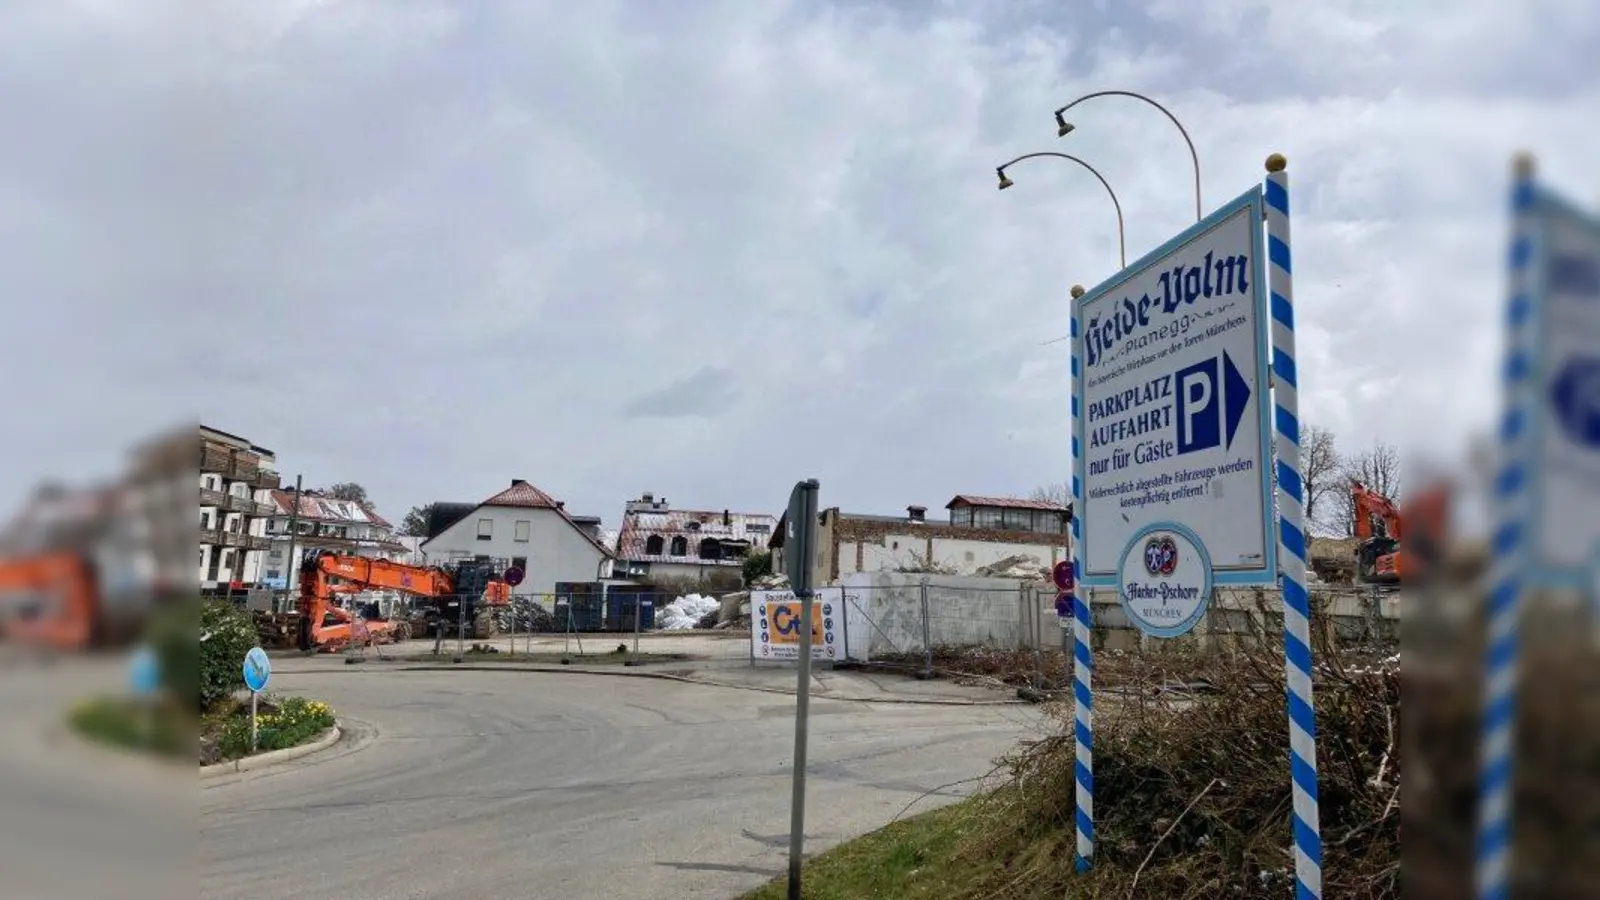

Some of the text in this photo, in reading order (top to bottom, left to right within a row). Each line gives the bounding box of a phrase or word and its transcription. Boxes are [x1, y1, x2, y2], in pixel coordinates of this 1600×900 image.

[1085, 250, 1249, 367] Heide-Volm
[1184, 333, 1204, 349] Toren
[1205, 315, 1247, 340] Münchens
[1089, 375, 1172, 422] PARKPLATZ
[1090, 405, 1172, 449] AUFFAHRT
[1090, 439, 1174, 477] nur für Gäste
[1089, 458, 1253, 499] Widerrechtlich abgestellte Fahrzeuge werden
[1120, 488, 1170, 508] kostenpflichtig
[1127, 581, 1199, 606] Hacker-Pschorr
[1142, 607, 1182, 618] MÜNCHEN
